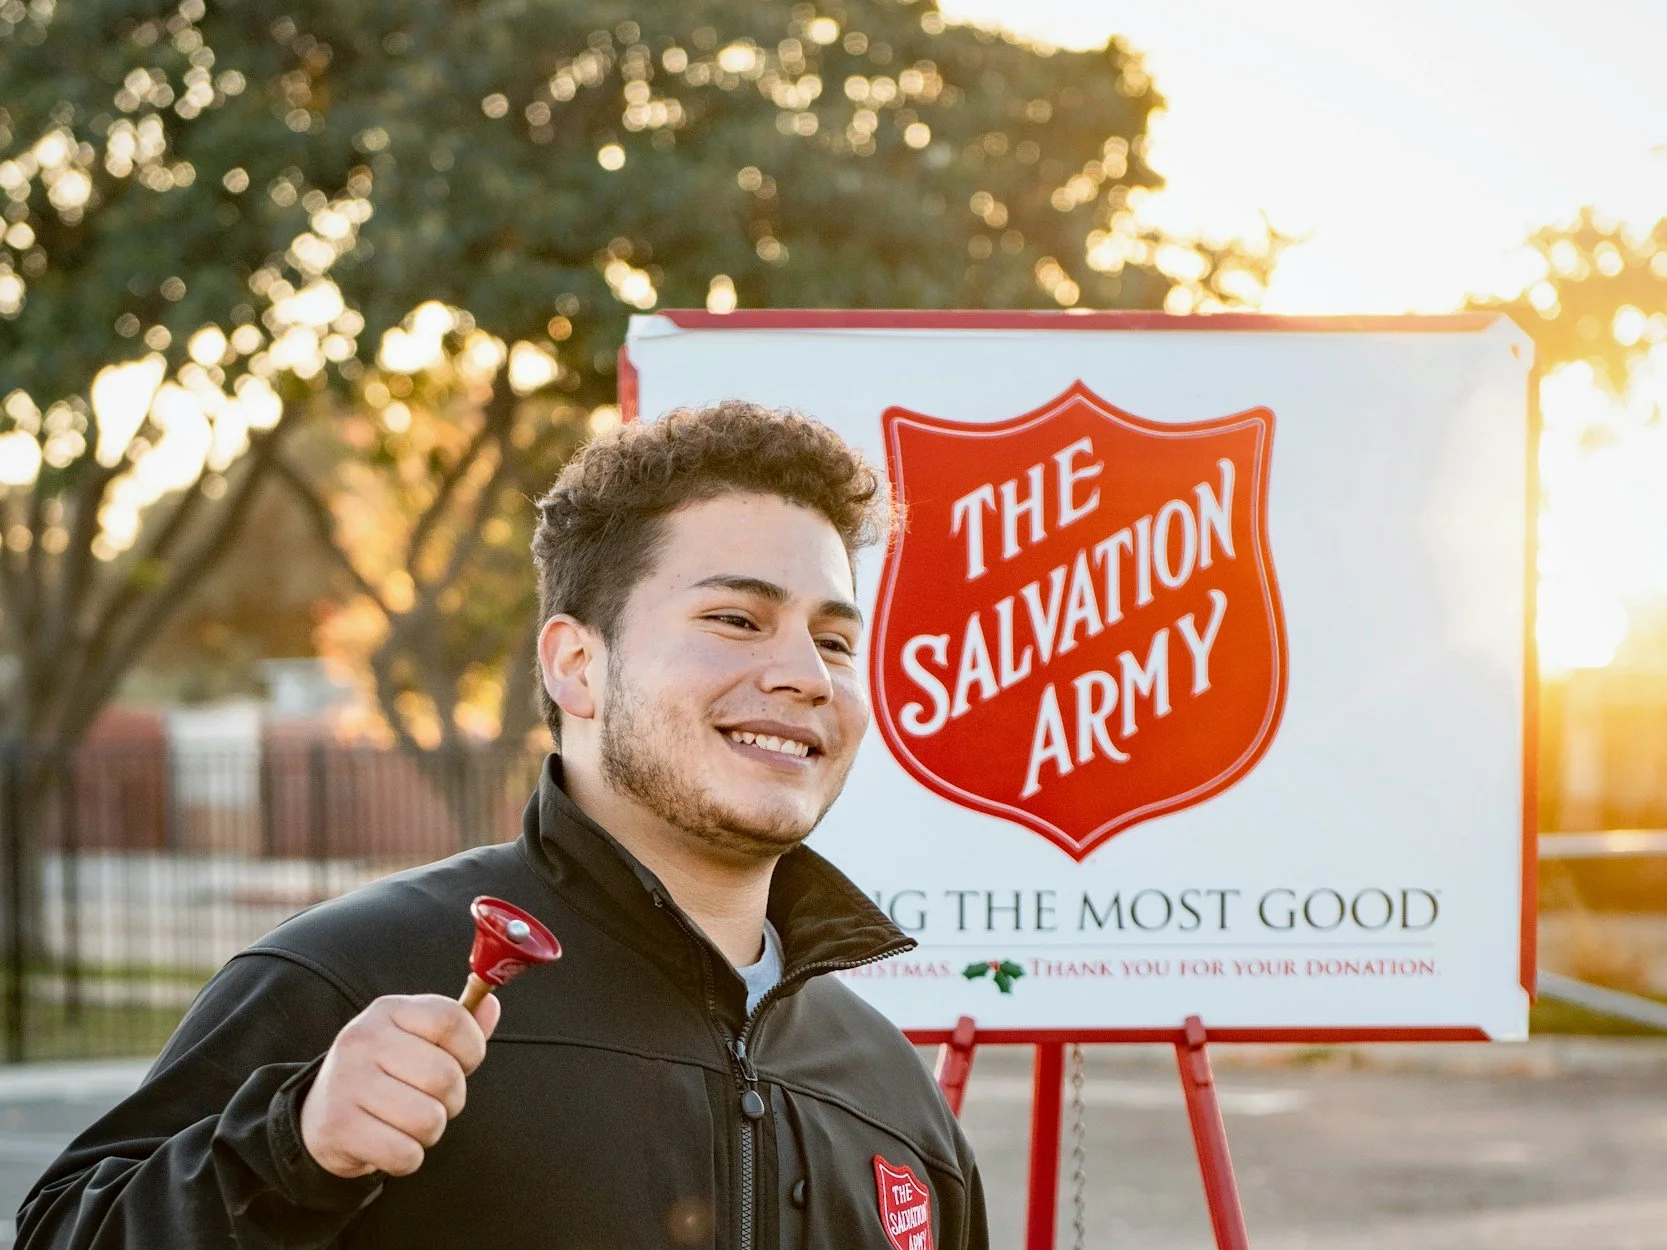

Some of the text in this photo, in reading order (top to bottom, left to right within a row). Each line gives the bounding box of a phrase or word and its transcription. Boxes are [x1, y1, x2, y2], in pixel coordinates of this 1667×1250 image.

[950, 436, 1104, 582] THE
[899, 457, 1236, 738] SALVATION
[1020, 588, 1228, 800] ARMY
[944, 888, 1058, 932] THE
[1076, 887, 1242, 933] MOST
[1257, 887, 1440, 933] GOOD
[1027, 957, 1113, 978] THANK
[1120, 958, 1171, 978] YOU
[1180, 958, 1225, 978] FOR
[1233, 958, 1298, 978] YOUR
[1305, 958, 1441, 978] DONATION.
[891, 1182, 913, 1206] THE
[889, 1201, 928, 1236] SALVATION
